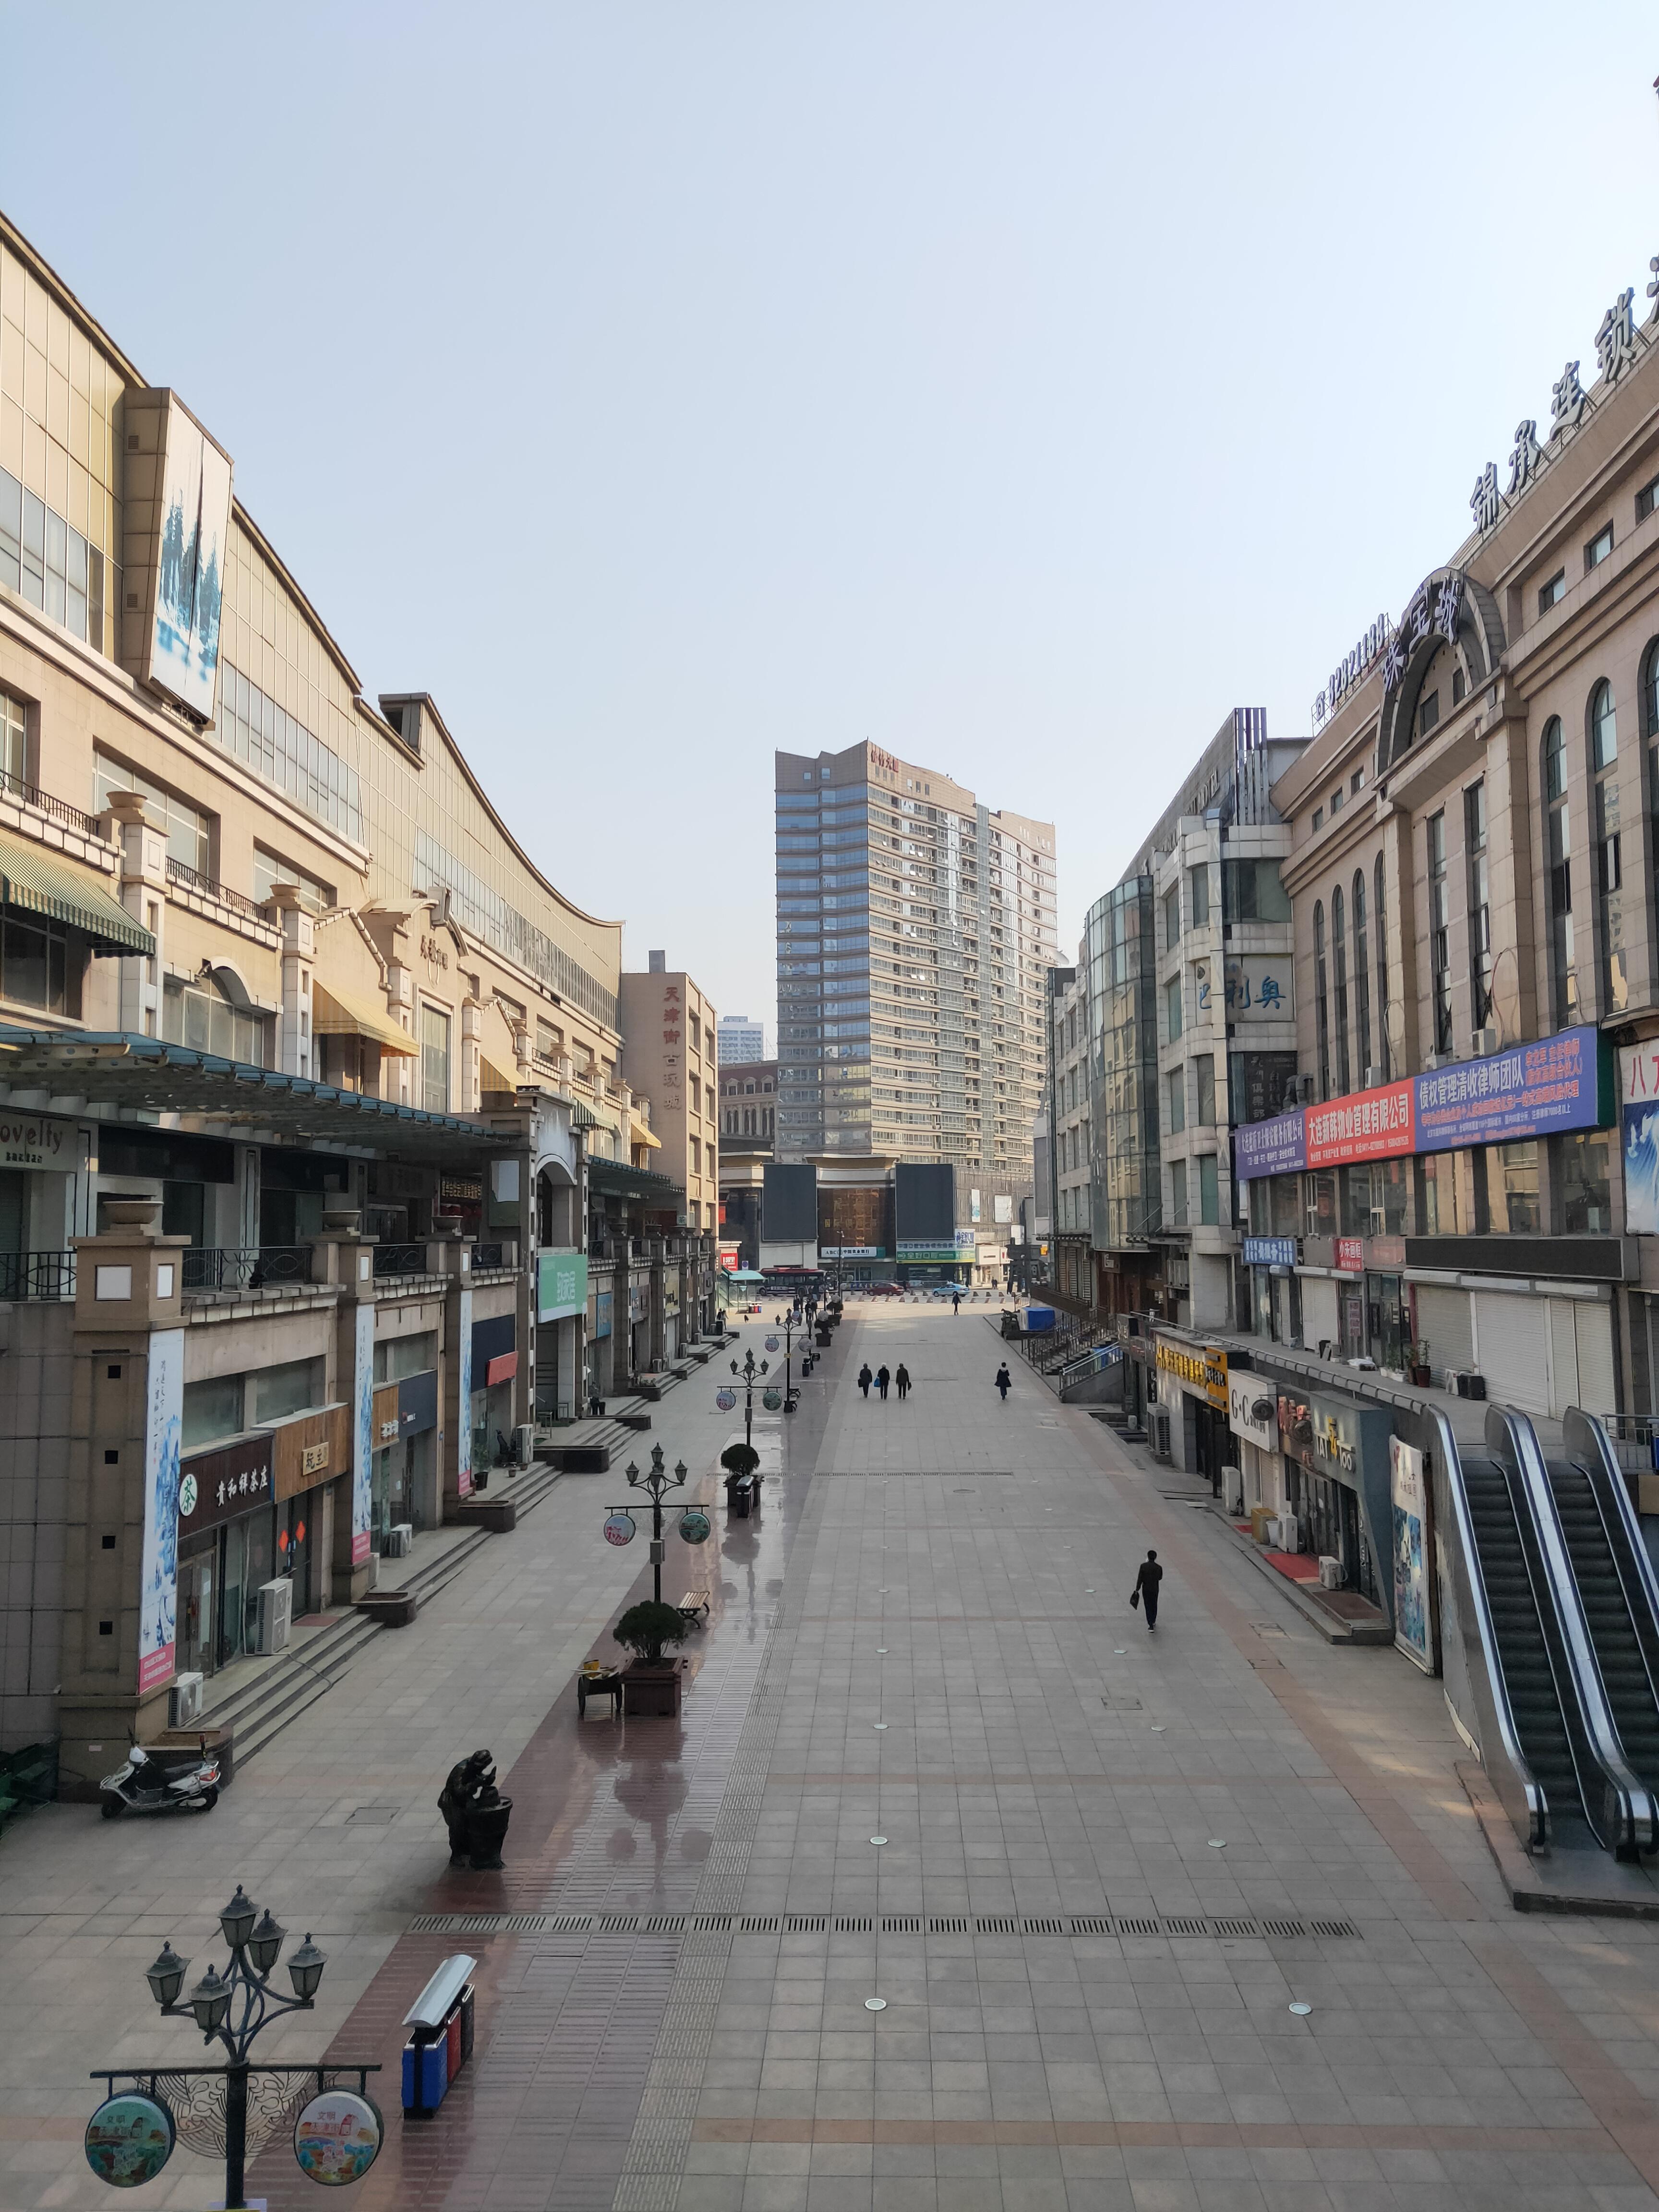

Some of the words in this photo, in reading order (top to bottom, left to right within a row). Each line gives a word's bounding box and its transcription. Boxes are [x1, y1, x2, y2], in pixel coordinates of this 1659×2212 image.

[1381, 575, 1459, 692] 珠宝城
[663, 986, 682, 1110] 天津街古玩城
[1419, 1055, 1524, 1110] 债权管理清收律师团队
[1339, 1242, 1361, 1259] 小朱画框
[182, 1477, 195, 1512] 茶
[107, 2115, 125, 2124] 文明
[312, 2122, 340, 2133] 天津街
[317, 2111, 336, 2121] 文明
